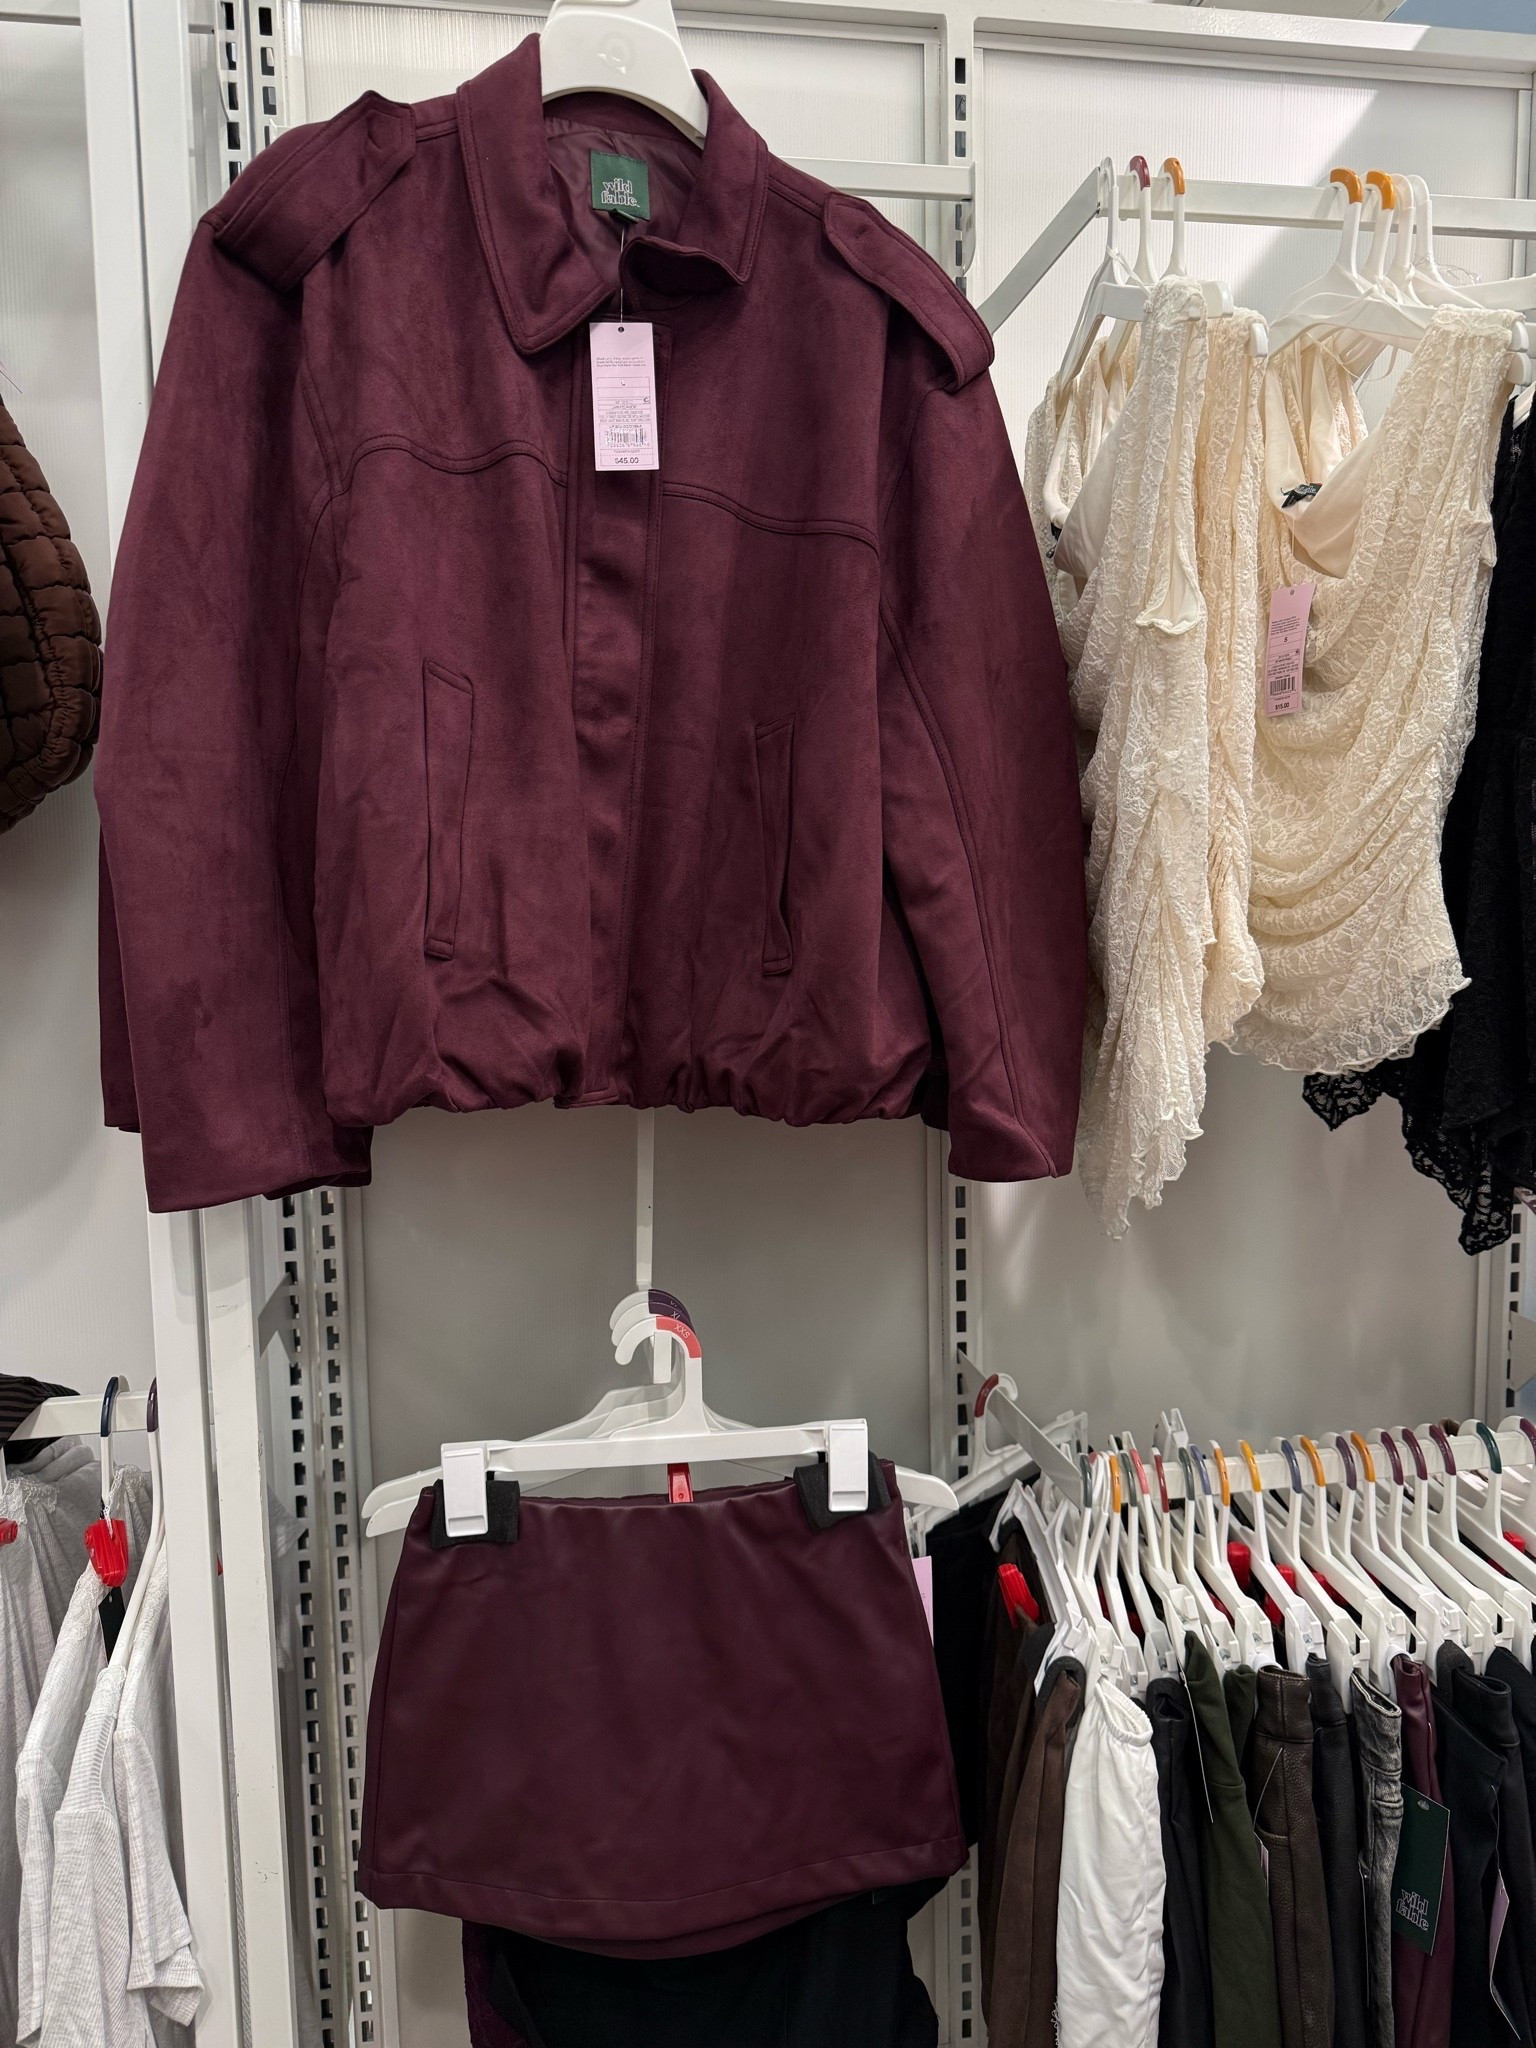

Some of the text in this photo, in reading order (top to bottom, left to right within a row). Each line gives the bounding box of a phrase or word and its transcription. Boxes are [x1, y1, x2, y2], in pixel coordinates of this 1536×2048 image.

[602, 177, 633, 194] wild
[614, 457, 640, 465] $45.00
[1275, 702, 1290, 711] $15.00
[674, 1323, 691, 1339] XXS
[1401, 1889, 1429, 1916] wild
